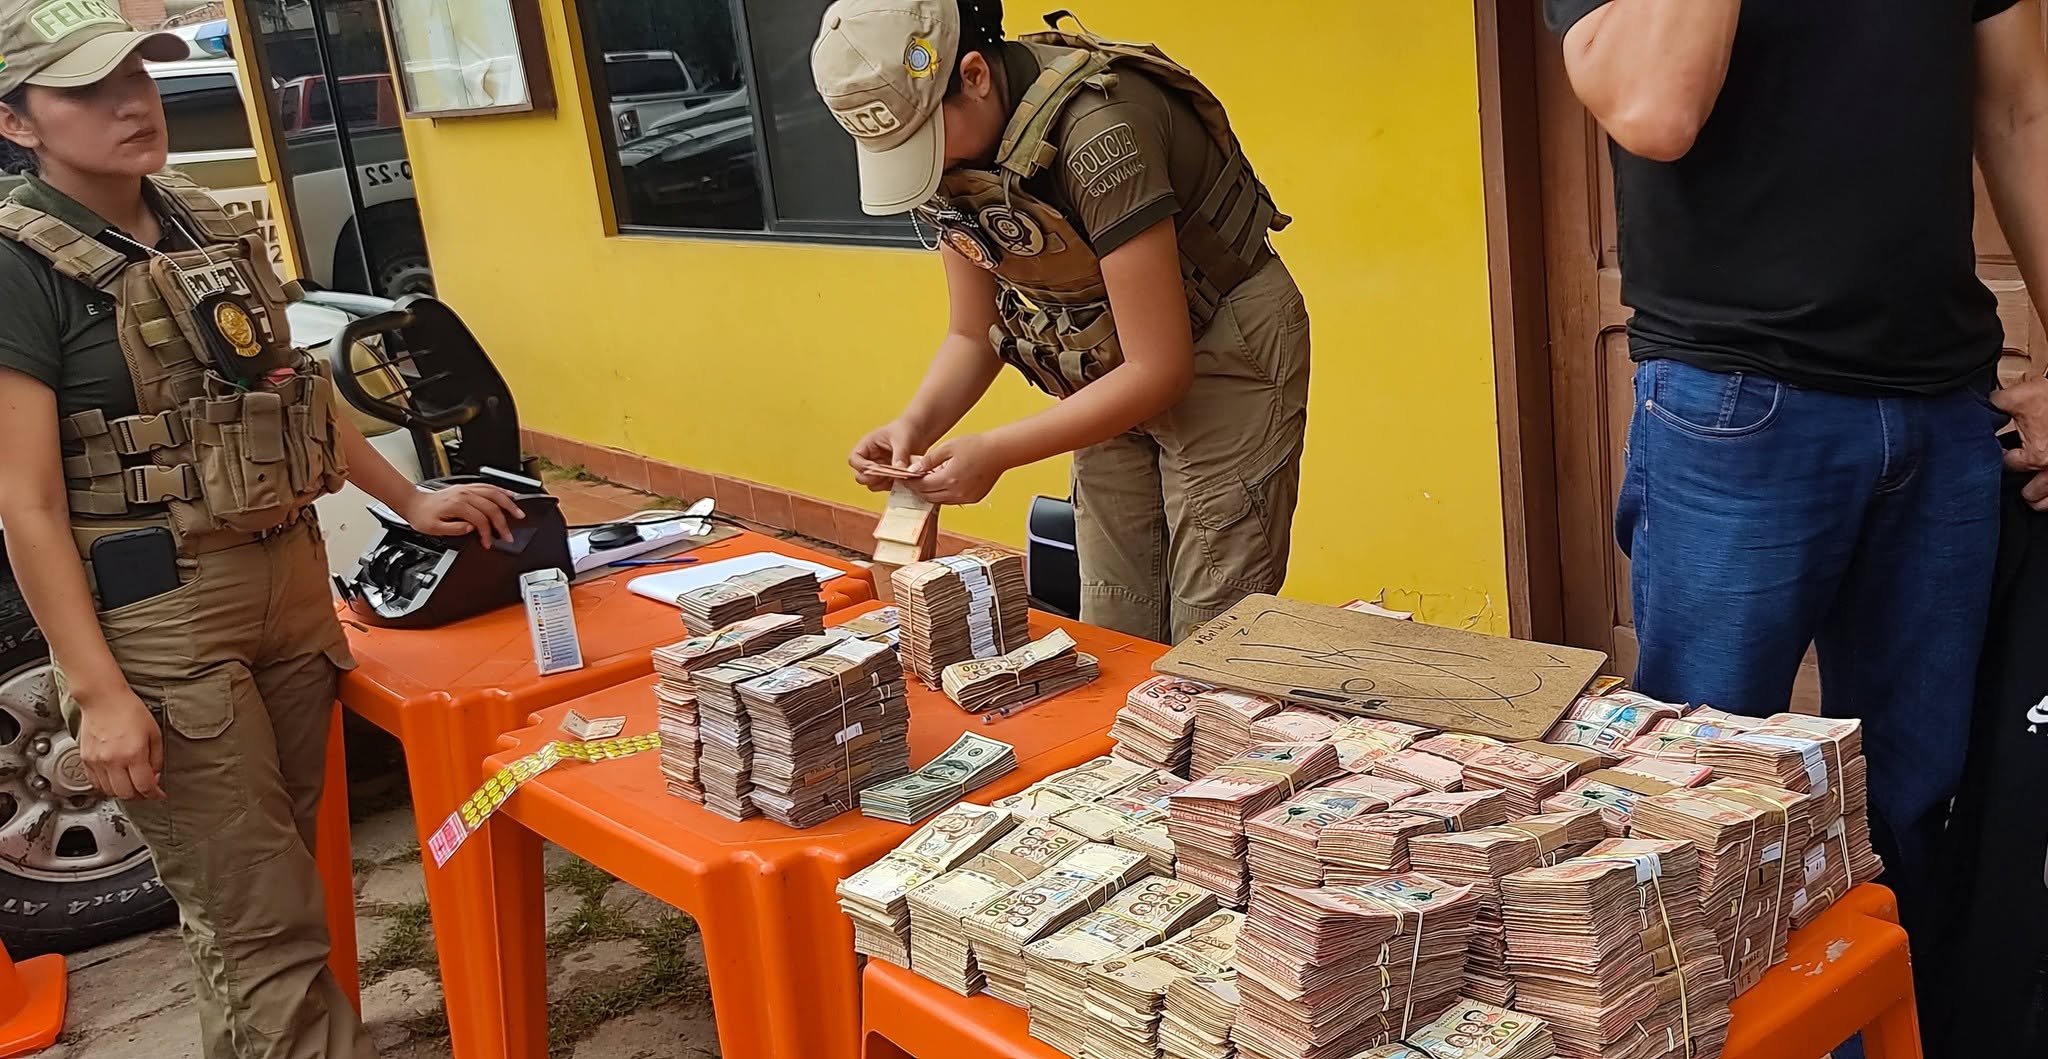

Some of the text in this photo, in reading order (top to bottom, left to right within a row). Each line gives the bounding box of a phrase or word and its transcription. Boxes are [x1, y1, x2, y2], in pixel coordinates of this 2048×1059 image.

[1072, 129, 1135, 183] POLICIA
[1303, 812, 1337, 829] 100
[1038, 837, 1068, 855] 200
[985, 898, 1018, 917] 200
[1159, 892, 1191, 911] 200
[1481, 1021, 1520, 1045] 200
